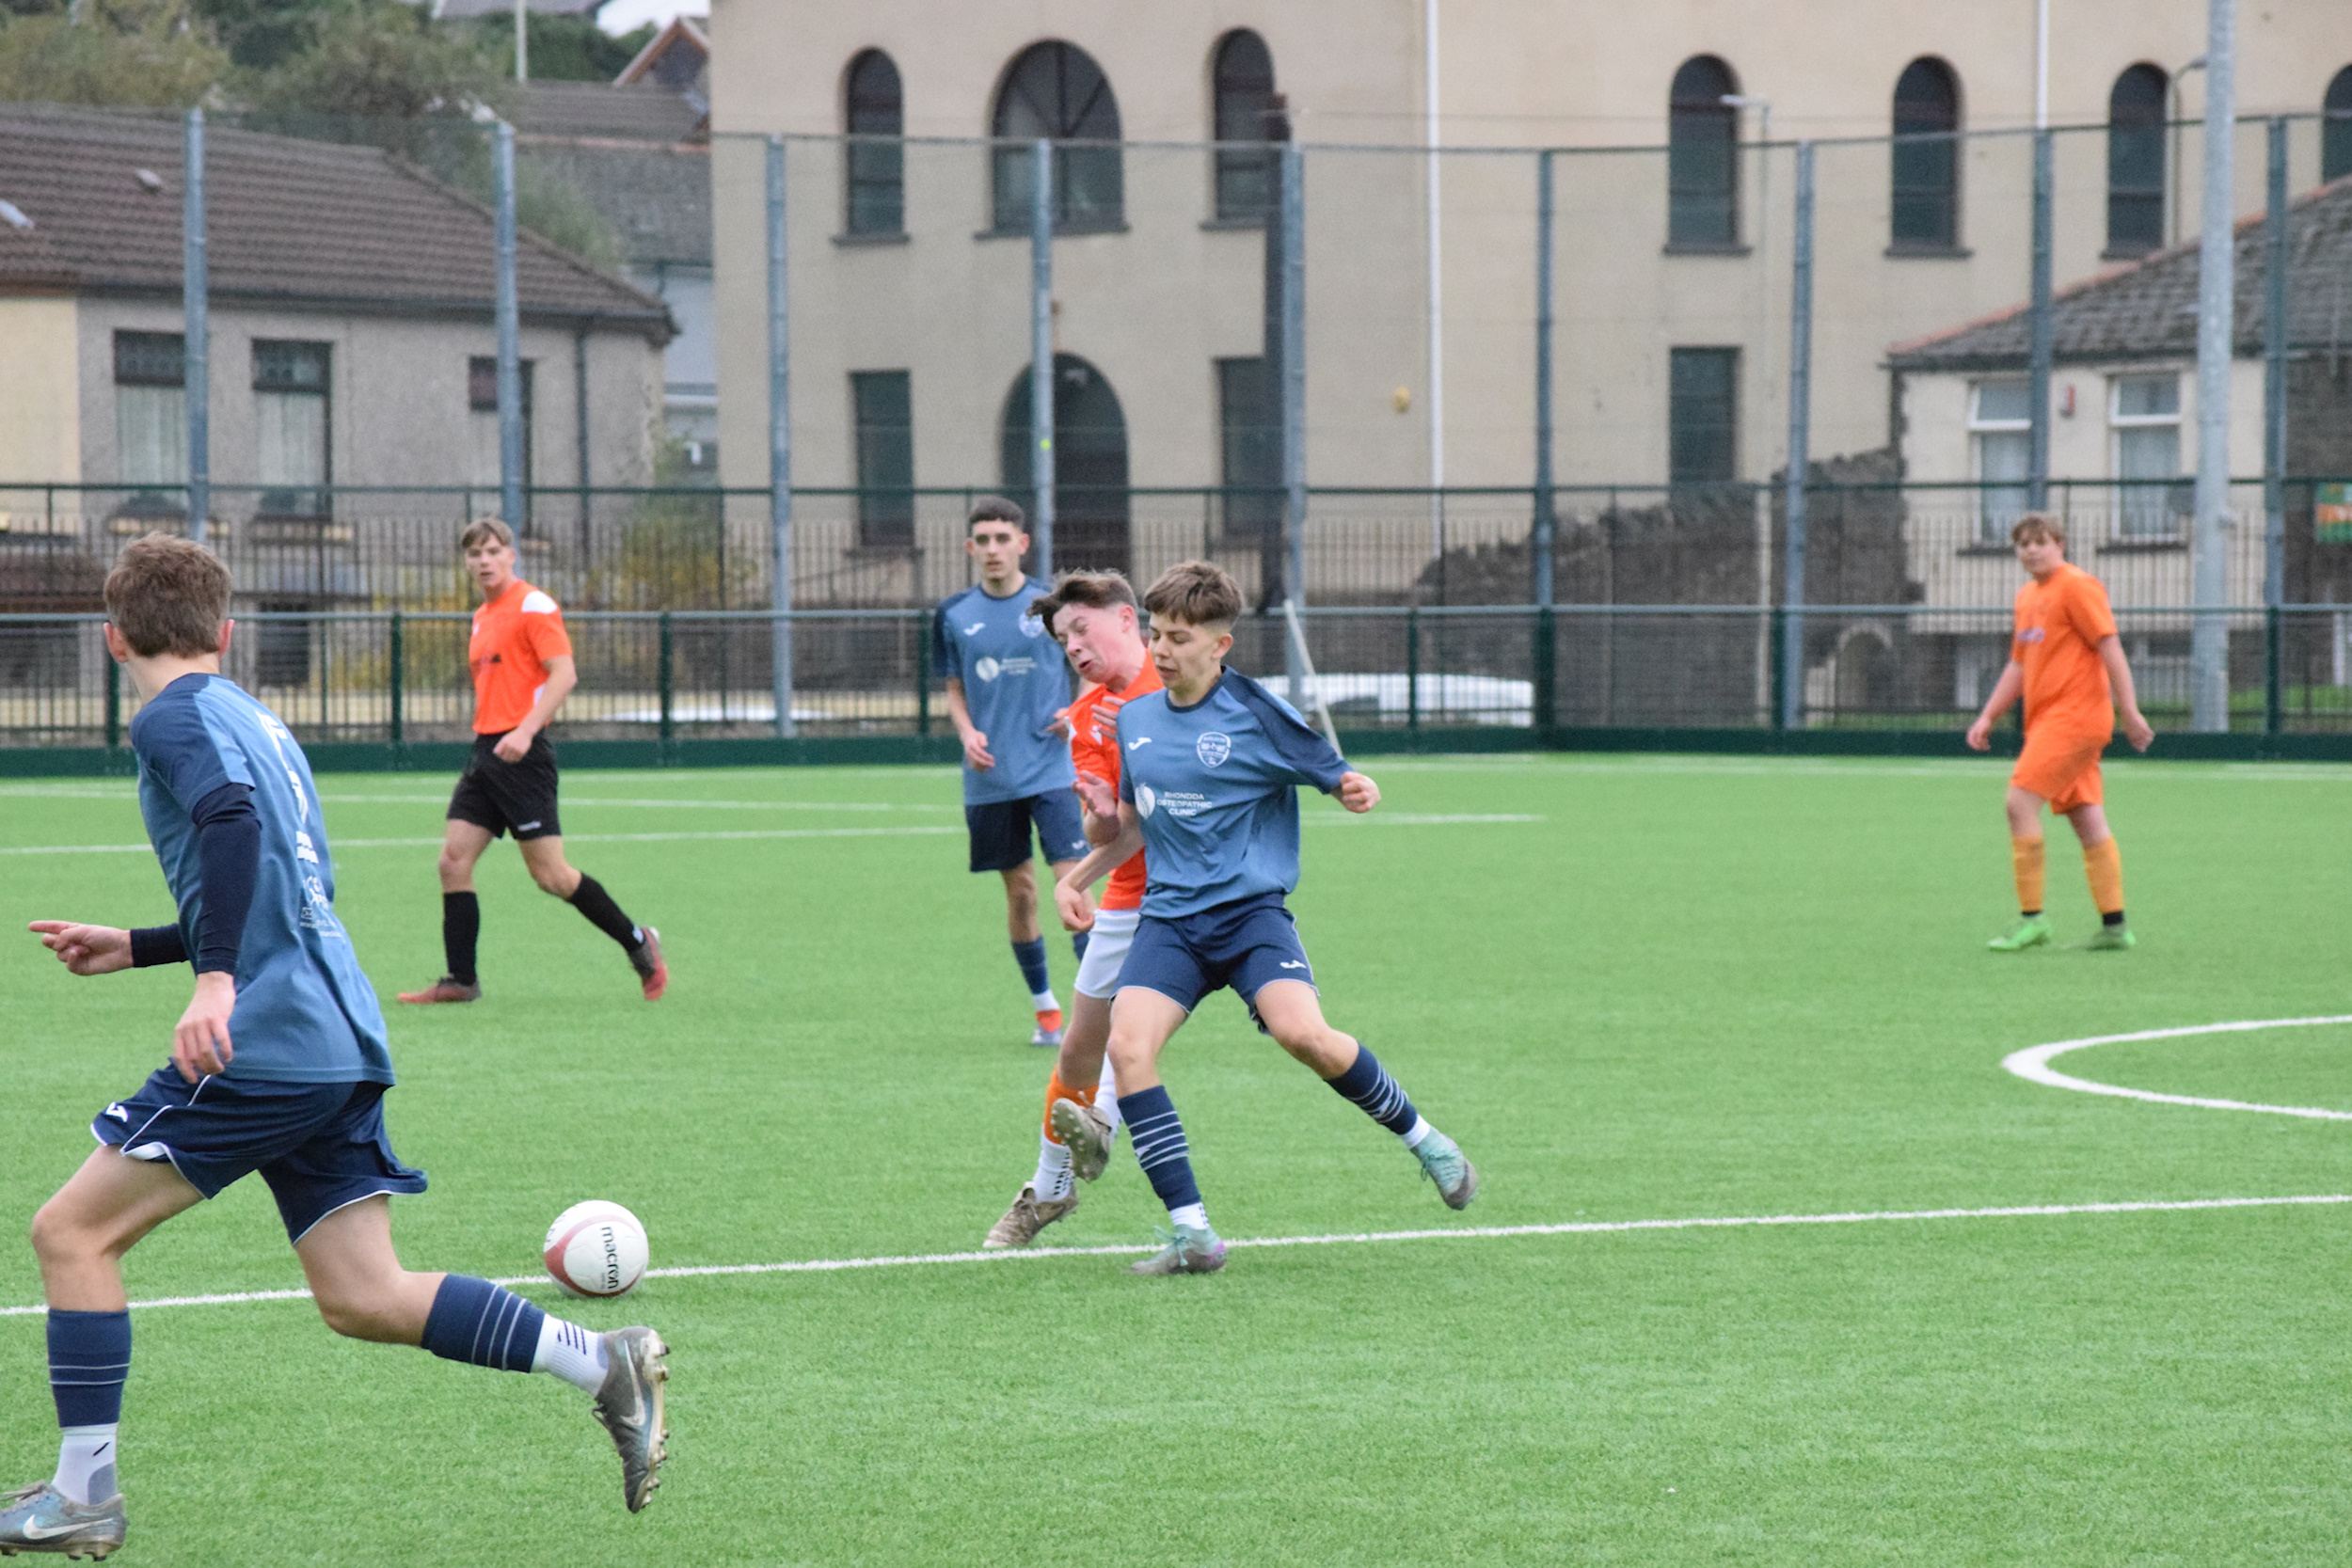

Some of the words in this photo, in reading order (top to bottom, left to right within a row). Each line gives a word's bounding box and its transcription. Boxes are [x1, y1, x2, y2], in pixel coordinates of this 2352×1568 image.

[1164, 791, 1204, 800] RHONDDA
[1156, 799, 1213, 809] OSTEOPATHIC
[1168, 807, 1197, 816] CLINIC
[601, 1226, 619, 1290] macron
